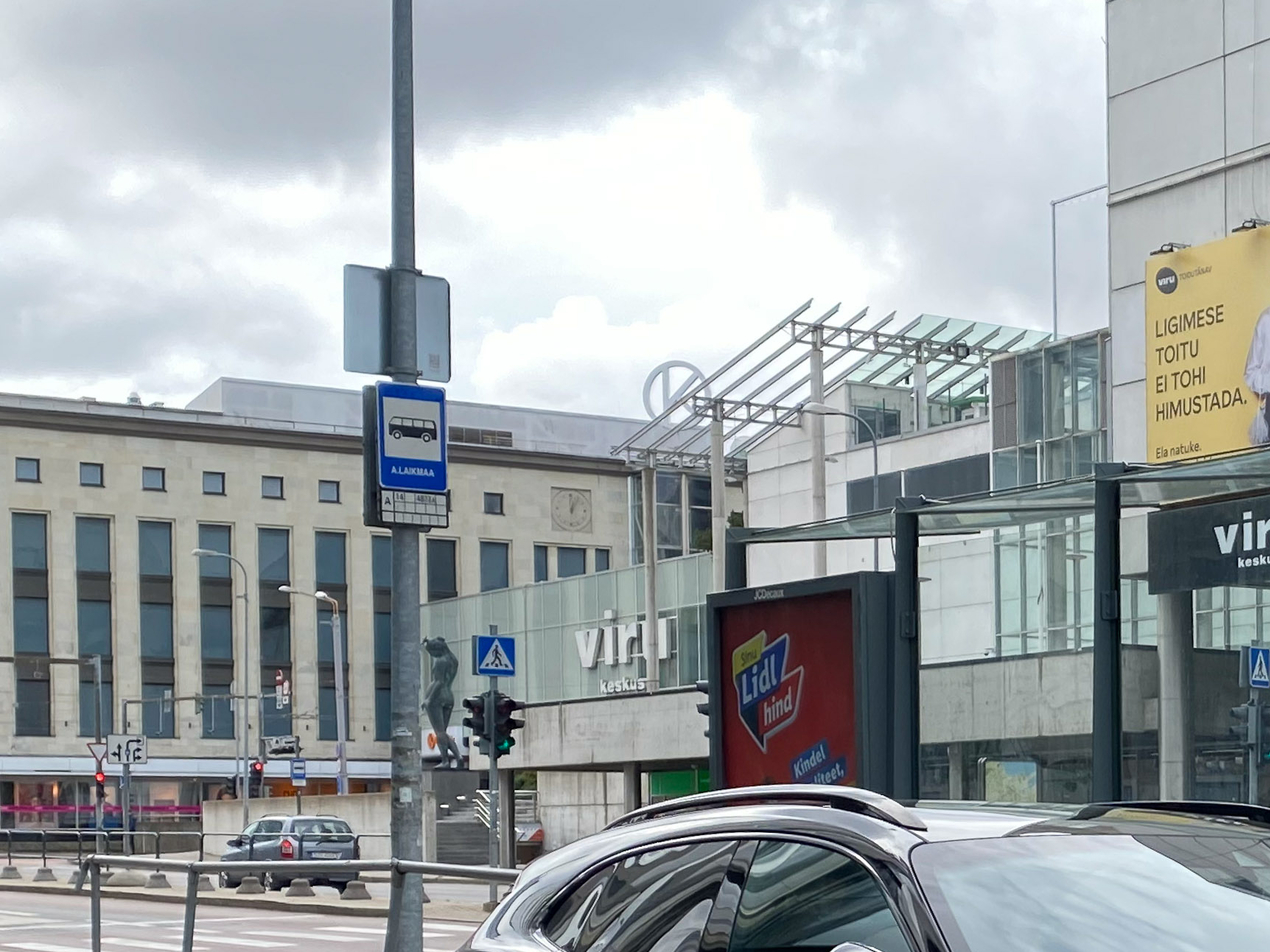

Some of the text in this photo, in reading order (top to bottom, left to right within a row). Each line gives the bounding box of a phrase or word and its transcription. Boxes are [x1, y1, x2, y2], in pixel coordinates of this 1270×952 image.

[1155, 304, 1224, 338] LIGIMESE
[1156, 339, 1199, 365] TOITU
[1156, 366, 1206, 394] EI TOHI
[1156, 387, 1247, 422] HIMUSTADA.
[1156, 441, 1202, 459] Ela natuke.
[600, 677, 646, 694] keskus
[742, 653, 778, 705] Lidl
[764, 686, 793, 726] hind
[794, 744, 826, 780] Kindel
